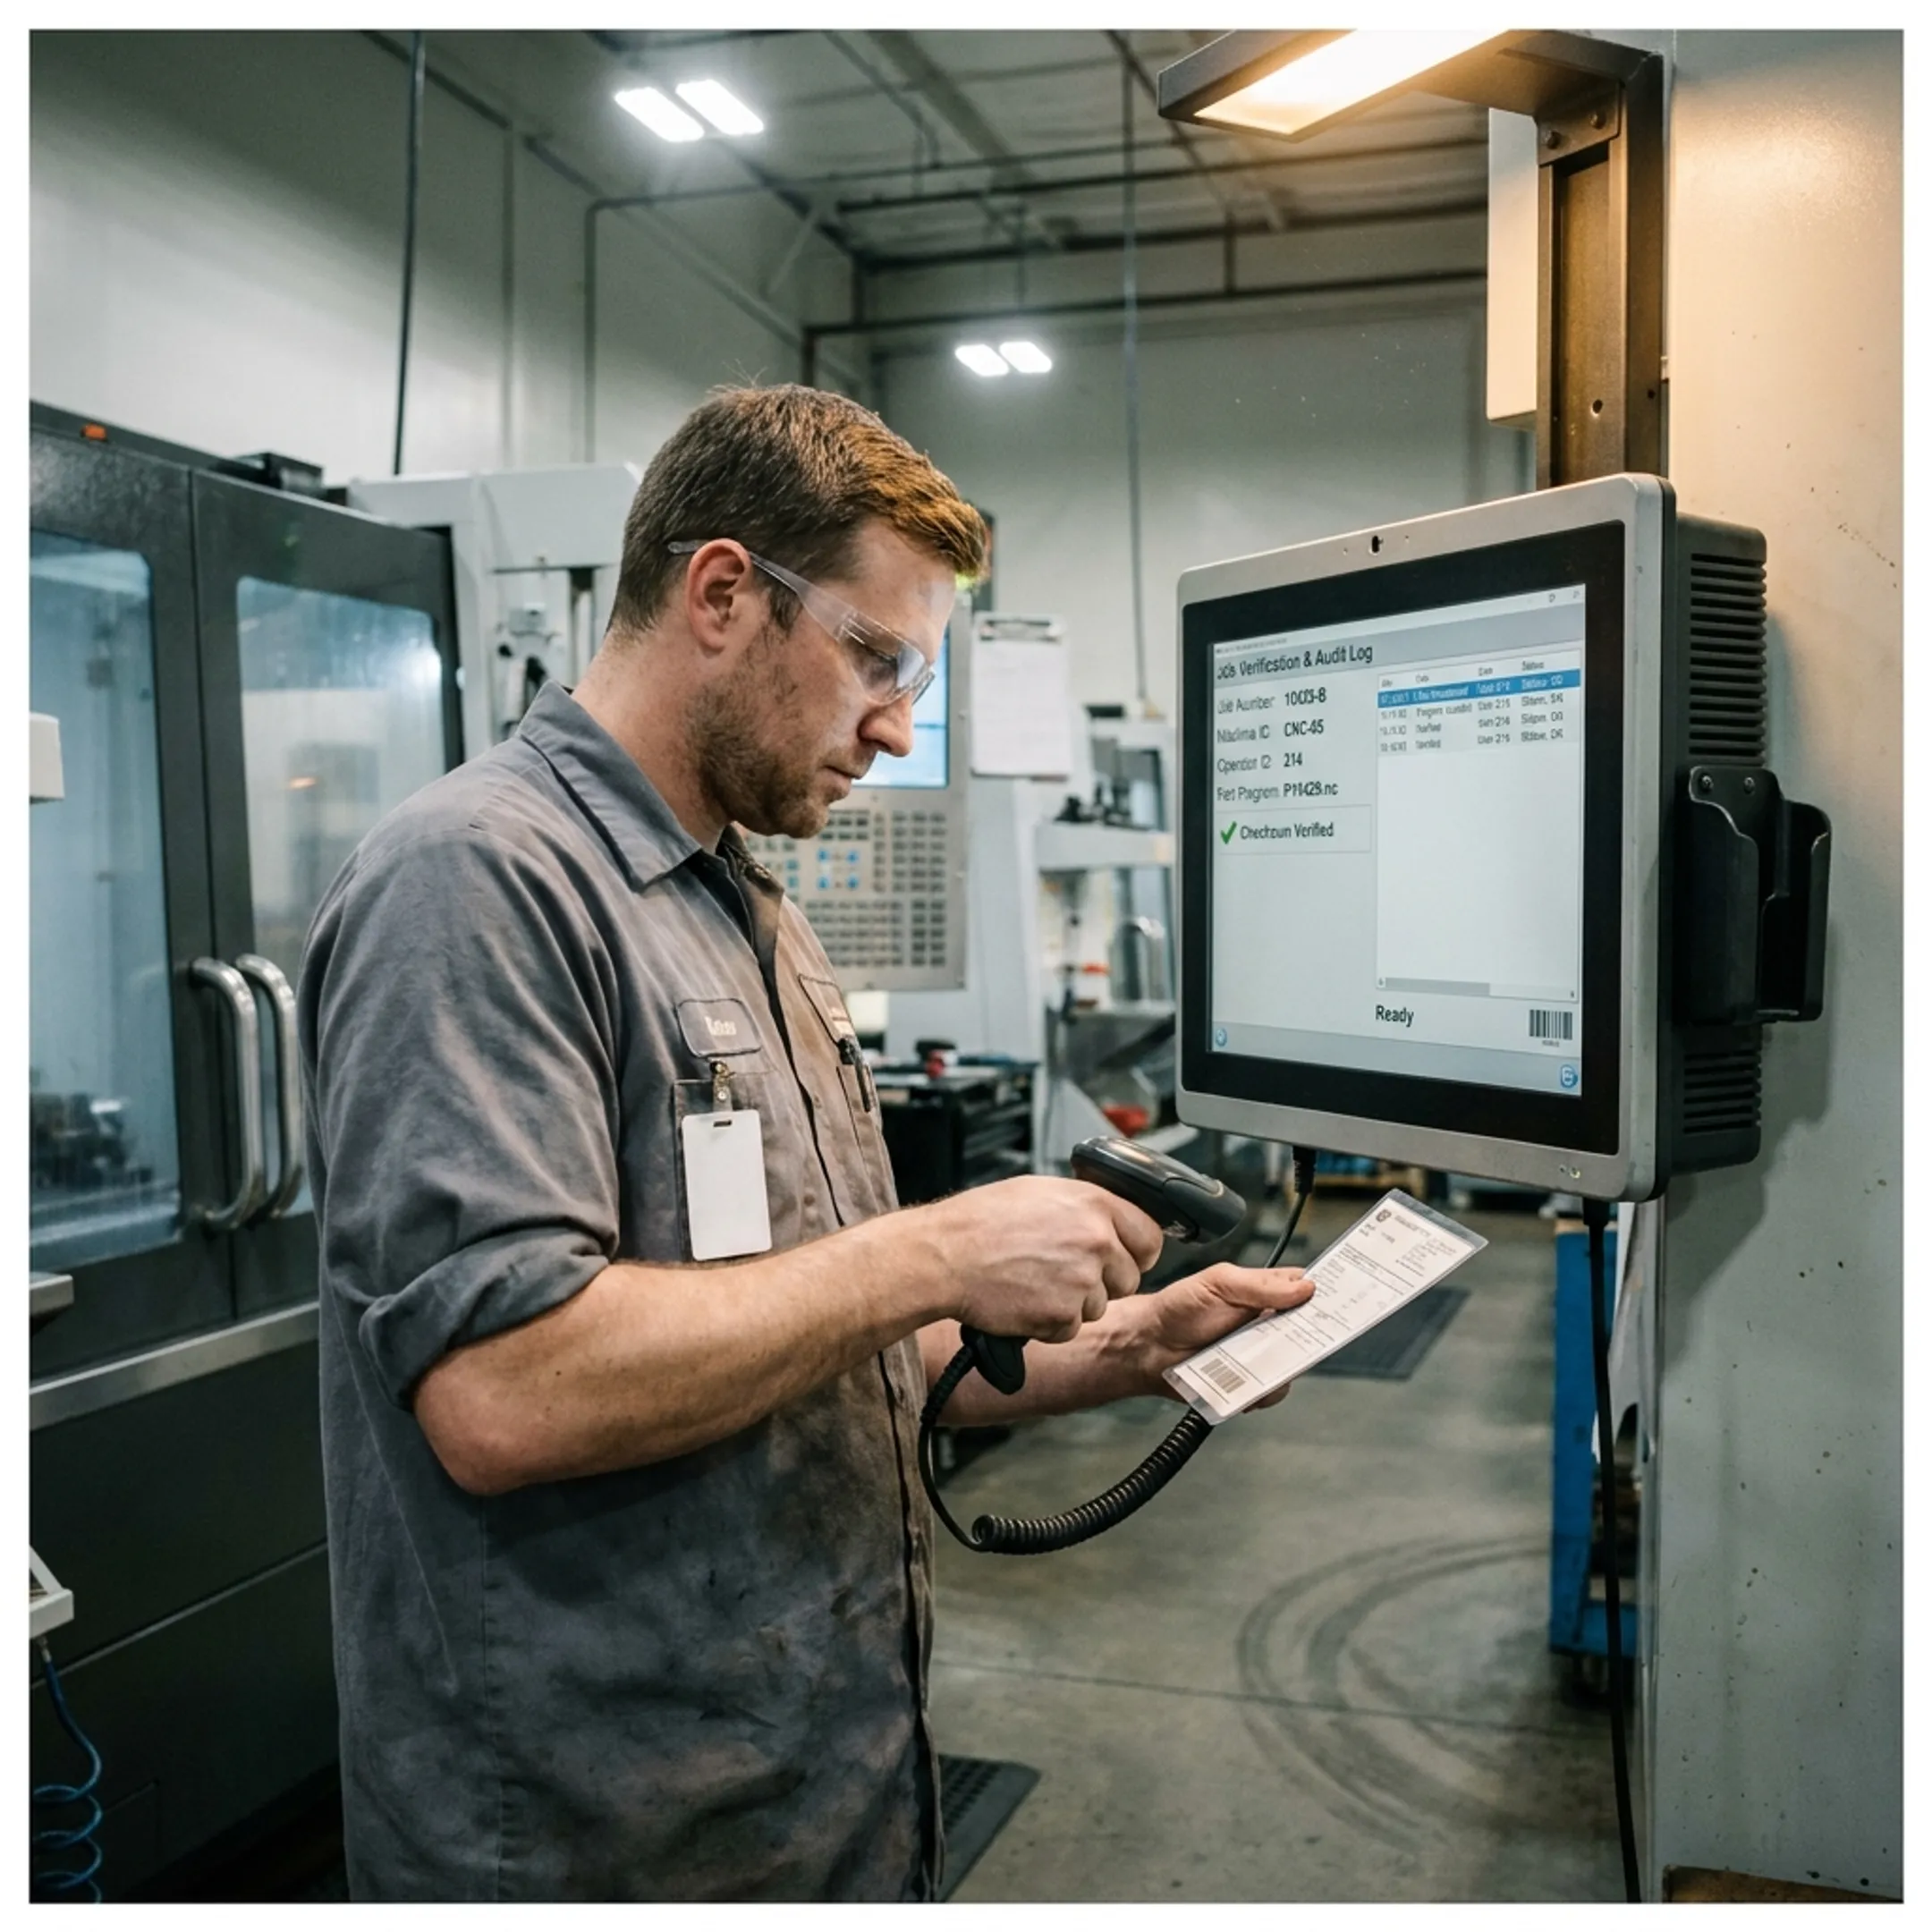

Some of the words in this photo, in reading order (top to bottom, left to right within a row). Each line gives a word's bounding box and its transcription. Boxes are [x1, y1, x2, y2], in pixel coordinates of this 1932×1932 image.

[1304, 650, 1312, 667] &
[1315, 646, 1346, 665] Audit
[1349, 645, 1373, 664] Log
[1284, 752, 1303, 767] 214
[1376, 1004, 1414, 1028] Ready
